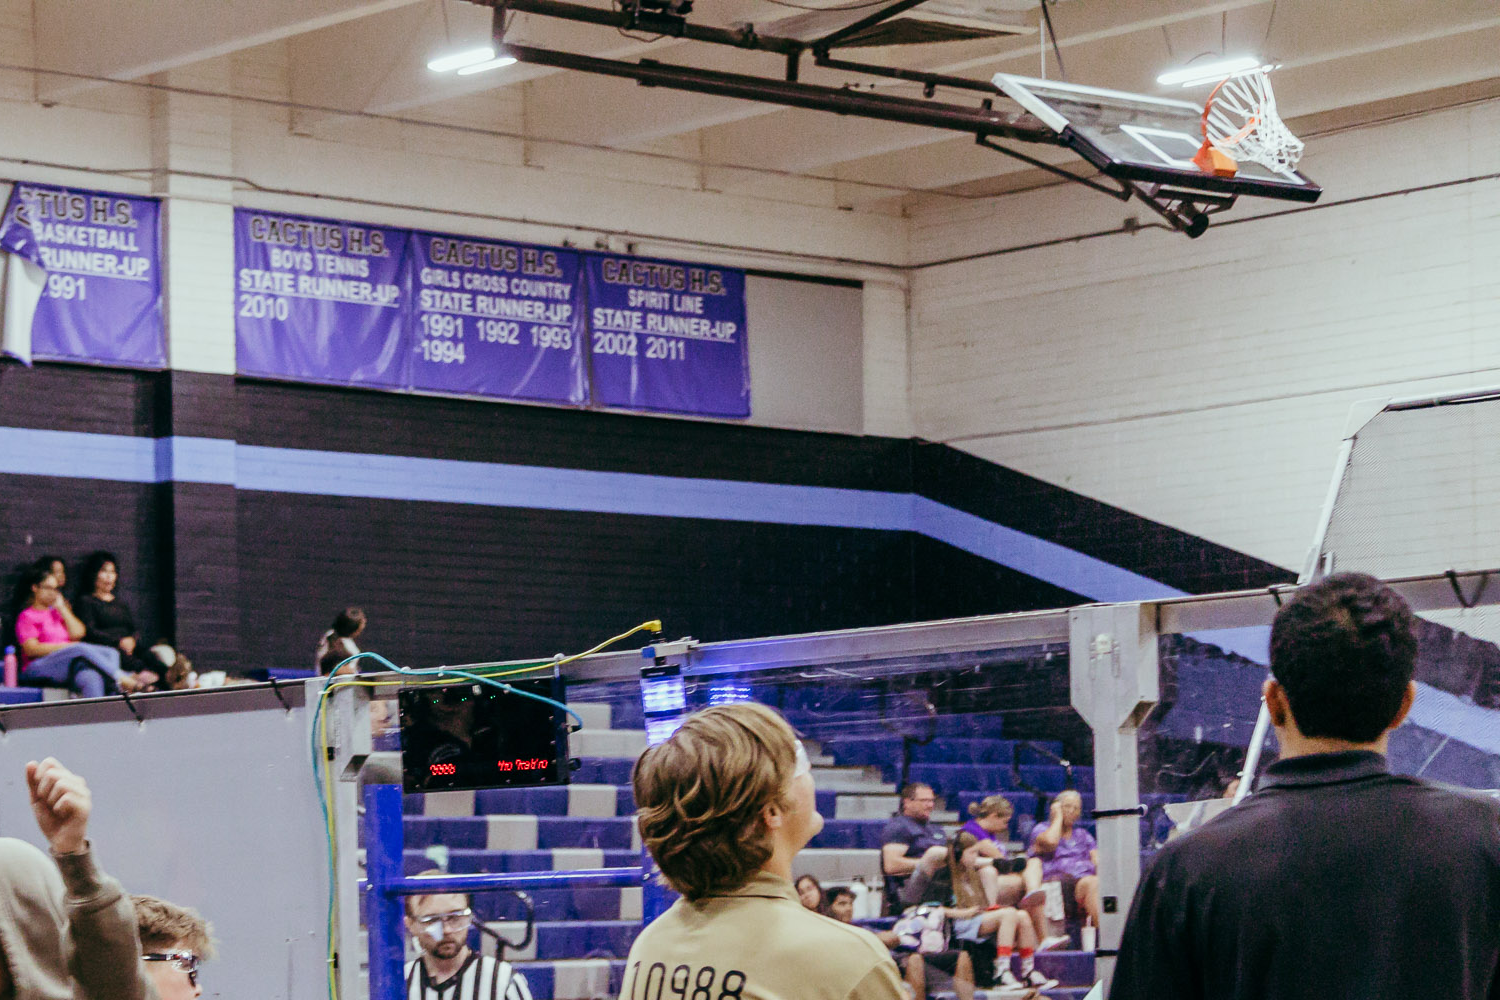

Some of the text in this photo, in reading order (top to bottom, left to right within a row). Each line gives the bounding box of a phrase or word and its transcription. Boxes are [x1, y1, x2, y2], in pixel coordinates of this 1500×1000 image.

[33, 189, 138, 228] TUS H.S.
[32, 220, 139, 252] BASKETBALL
[251, 216, 390, 258] CACTUS H.S.
[38, 247, 150, 276] RUNNER-UP
[270, 248, 370, 278] BOYS TENNIS
[430, 237, 563, 278] CACTUS H.S.
[45, 273, 86, 300] 991
[239, 268, 400, 304] STATE RUNNER-UP
[420, 267, 573, 300] GIRLS CROSS COUNTRY
[601, 258, 727, 296] CACTUS H.S.
[239, 294, 289, 321] 2010
[420, 288, 573, 322] STATE RUNNER-UP
[627, 289, 704, 315] SPIRIT LINE
[420, 313, 573, 350] 1991 1992 1993
[593, 307, 737, 340] STATE RUNNER-UP
[420, 339, 466, 365] 1994
[593, 331, 686, 361] 2002 2011
